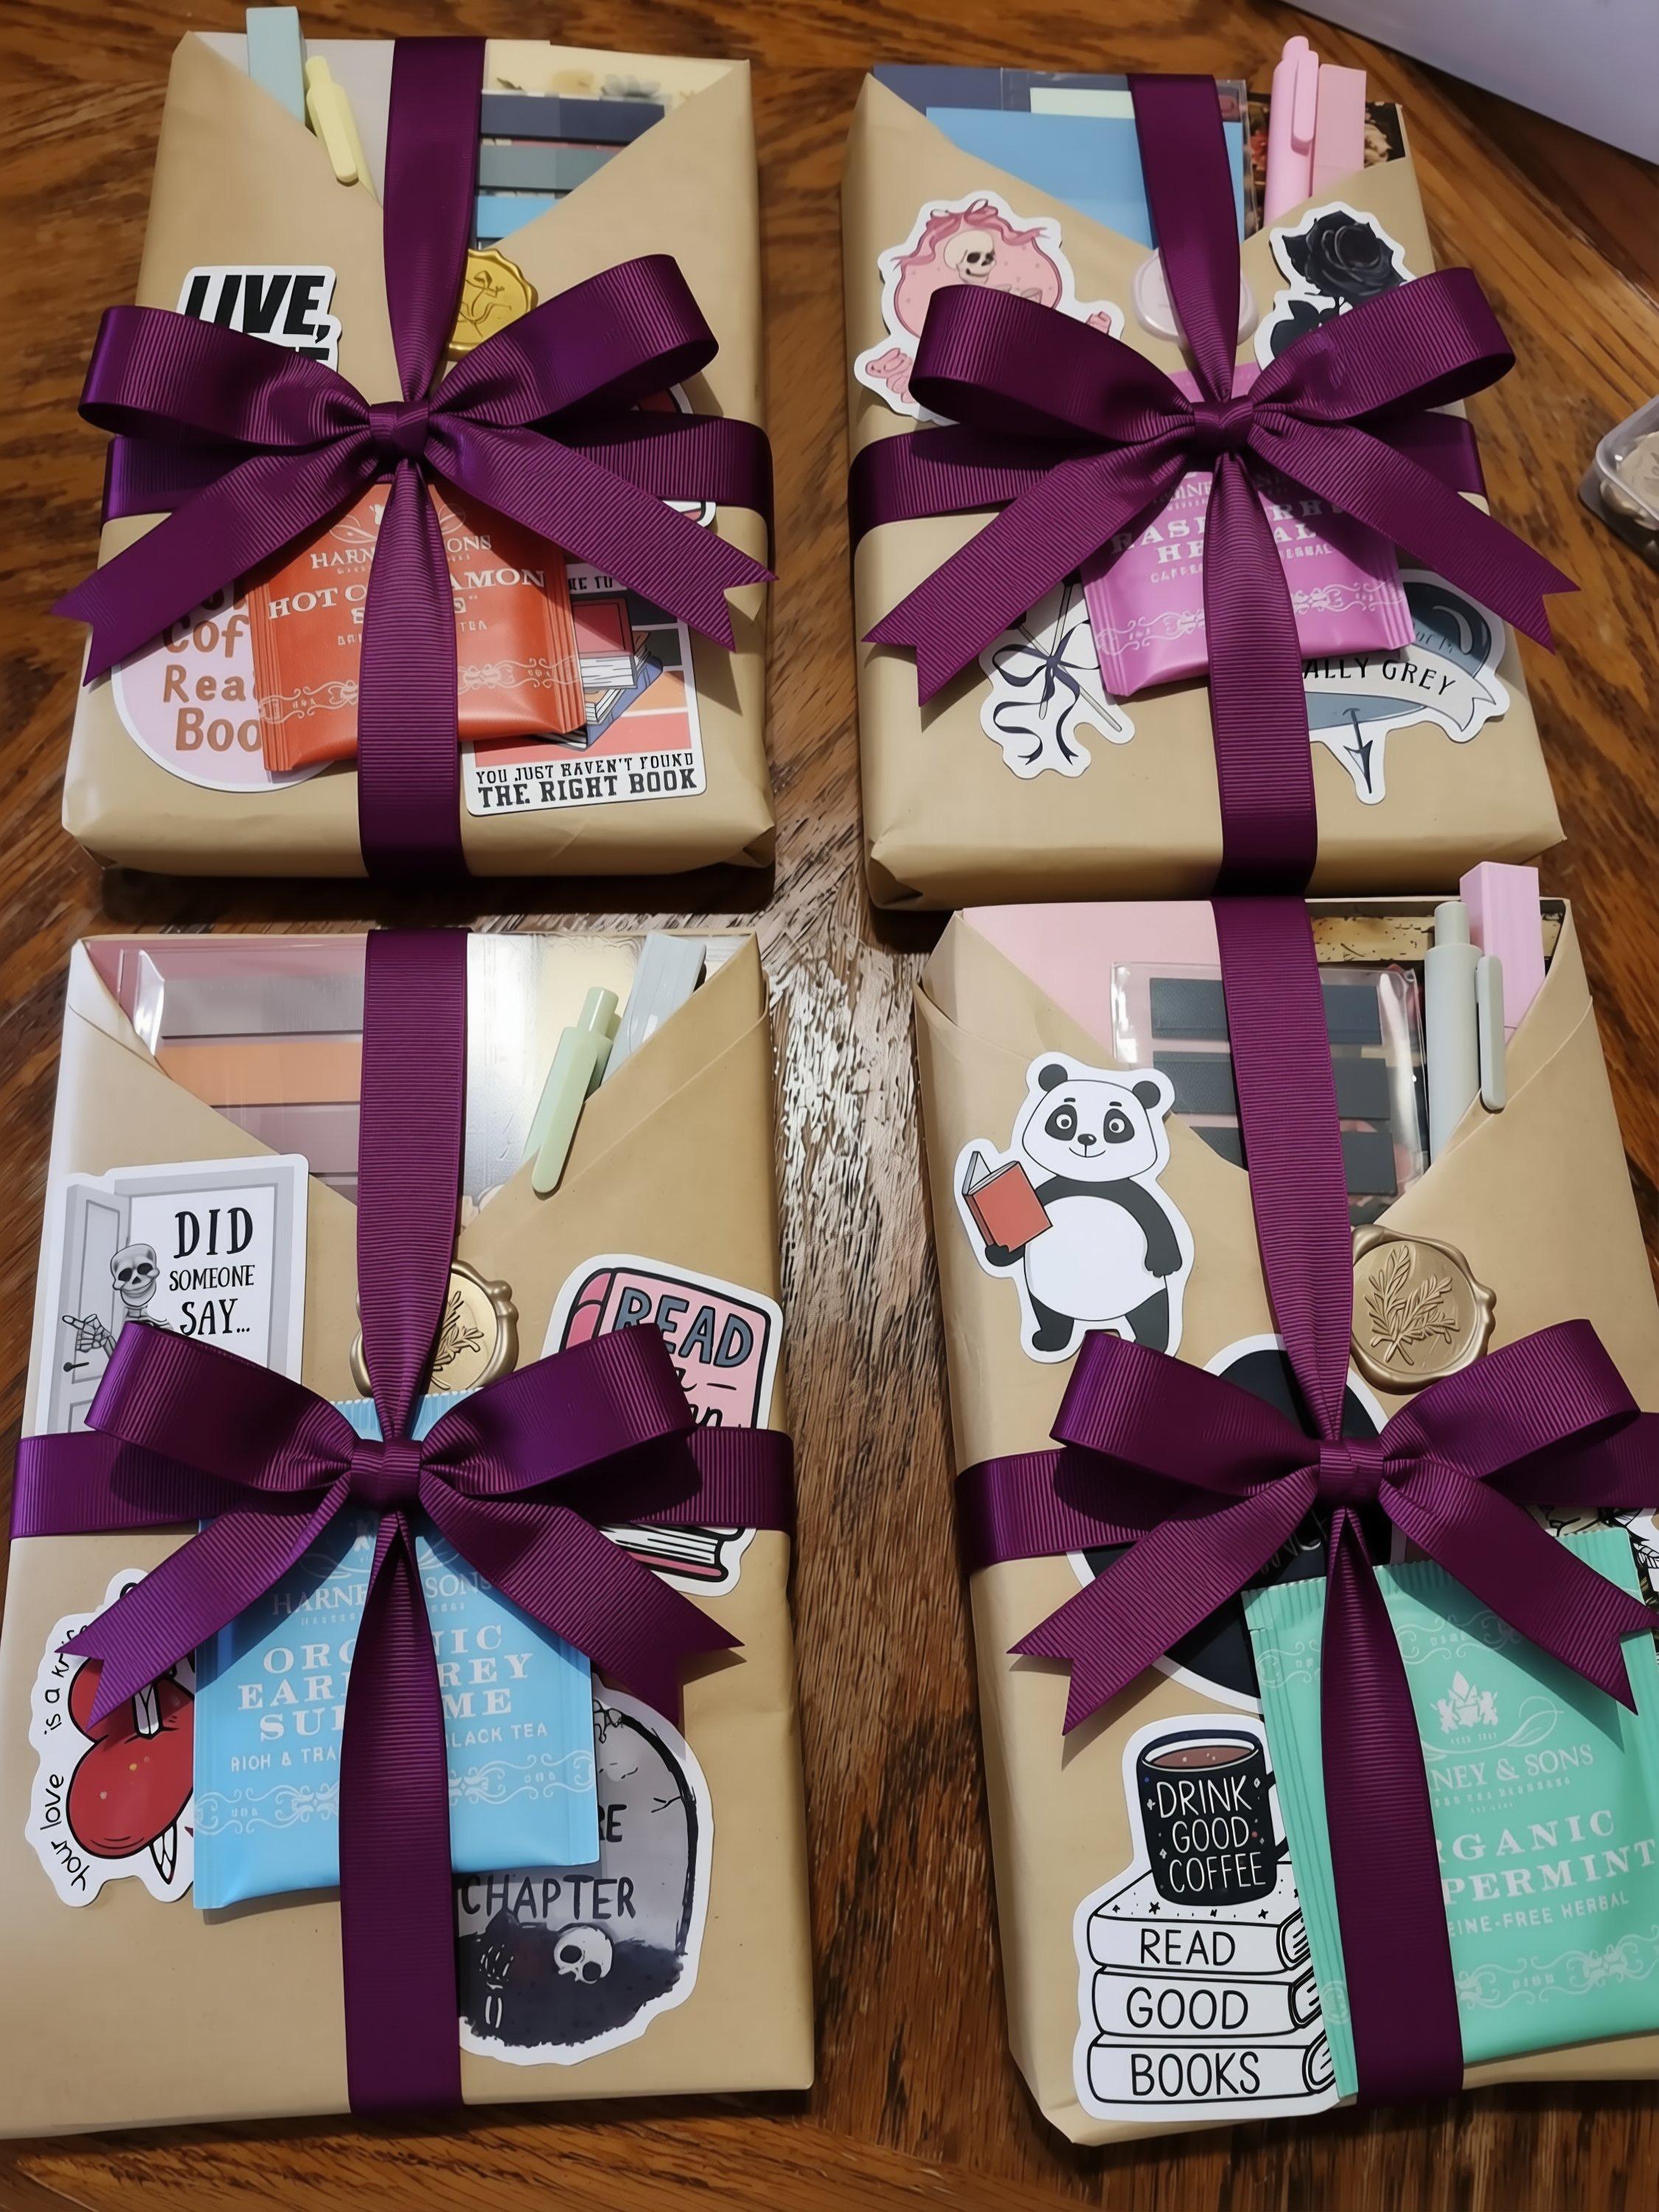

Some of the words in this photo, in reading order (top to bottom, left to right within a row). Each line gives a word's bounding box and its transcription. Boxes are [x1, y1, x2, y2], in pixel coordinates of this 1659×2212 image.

[269, 588, 338, 619] HOT
[161, 665, 258, 703] Rea
[1382, 658, 1455, 695] GREY
[476, 771, 507, 785] YOU
[515, 765, 553, 782] JUST
[478, 783, 530, 808] THE
[539, 775, 618, 802] RIGHT
[628, 768, 698, 794] BOOK
[173, 1207, 254, 1259] DID
[170, 1265, 255, 1291] SOMEONE
[180, 1298, 250, 1336] SAY...
[613, 1286, 754, 1368] READ
[425, 1572, 492, 1598] SONS
[45, 1688, 60, 1703] a
[44, 1714, 62, 1735] is
[511, 1722, 548, 1739] TEA
[1496, 1759, 1520, 1781] &
[1525, 1744, 1593, 1776] SONS
[40, 1773, 65, 1830] love
[1156, 1775, 1253, 1819] DRINK
[1172, 1816, 1249, 1854] GOOD
[1169, 1851, 1266, 1893] COFFEE
[461, 1874, 636, 1920] CHAPTER
[1561, 1890, 1630, 1919] HERBAL
[1141, 1928, 1236, 1966] READ
[1126, 1986, 1249, 2030] GOOD
[1131, 2051, 1261, 2097] BOOKS
